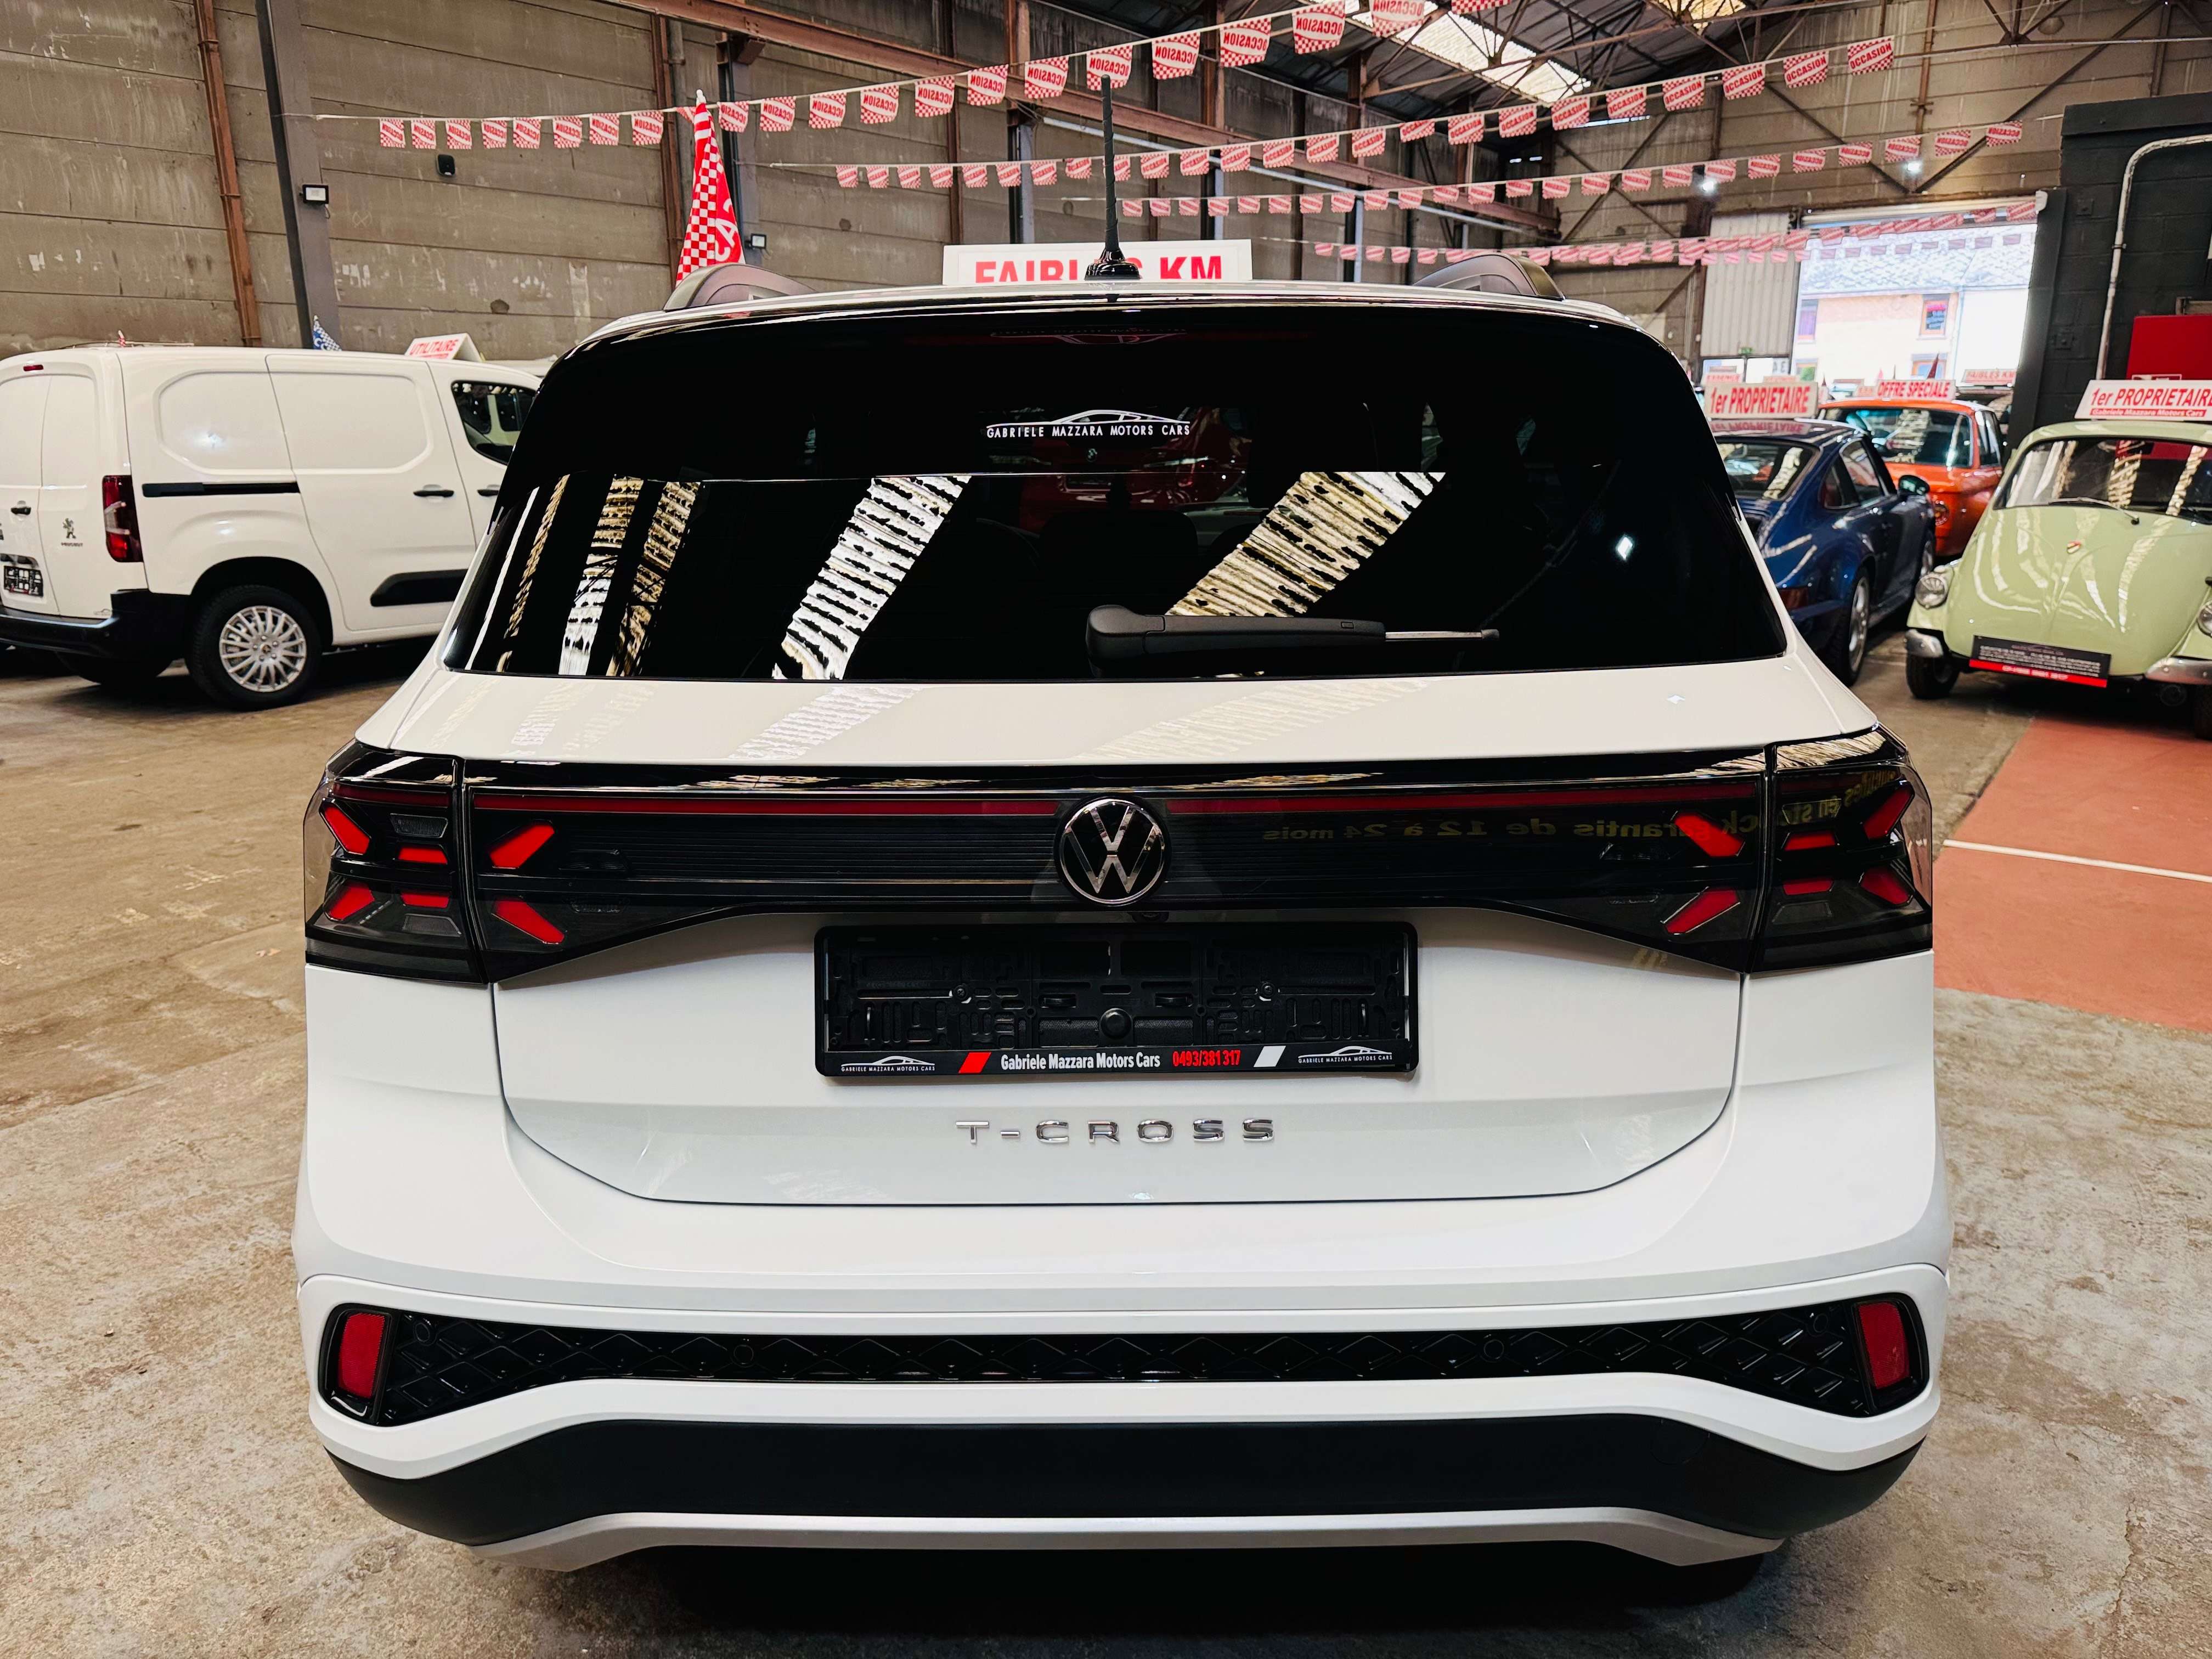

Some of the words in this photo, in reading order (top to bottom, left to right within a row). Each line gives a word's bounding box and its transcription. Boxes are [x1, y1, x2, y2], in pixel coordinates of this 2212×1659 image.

[1850, 43, 1892, 69] OCCASION
[1786, 55, 1826, 82] OCCASION
[1724, 69, 1763, 93] OCCASION
[1665, 82, 1702, 105] OCCASION
[1501, 111, 1534, 131] OCCASION
[1553, 103, 1588, 123] OCCASION
[1450, 120, 1481, 137] OCCASION
[975, 257, 1143, 283] FAIBL
[1160, 256, 1222, 280] KM
[1711, 387, 1728, 414] 1er
[1729, 386, 1811, 414] PROPRIETAIRE
[1877, 382, 1905, 397] OFFRE
[1907, 381, 1951, 398] SPECIALE
[2091, 388, 2114, 406] 1er
[2113, 388, 2212, 407] PROPRIETAIR
[987, 426, 1045, 438] GABRIELE
[1052, 425, 1103, 437] MAZZARA
[1110, 425, 1153, 436] MOTORS
[1161, 425, 1190, 436] CARS
[1001, 1053, 1046, 1070] Gabriele
[1048, 1053, 1094, 1069] Mazzara
[1096, 1052, 1135, 1069] Motors
[1136, 1052, 1161, 1068] Cars
[955, 1118, 1275, 1144] T-CROSS
